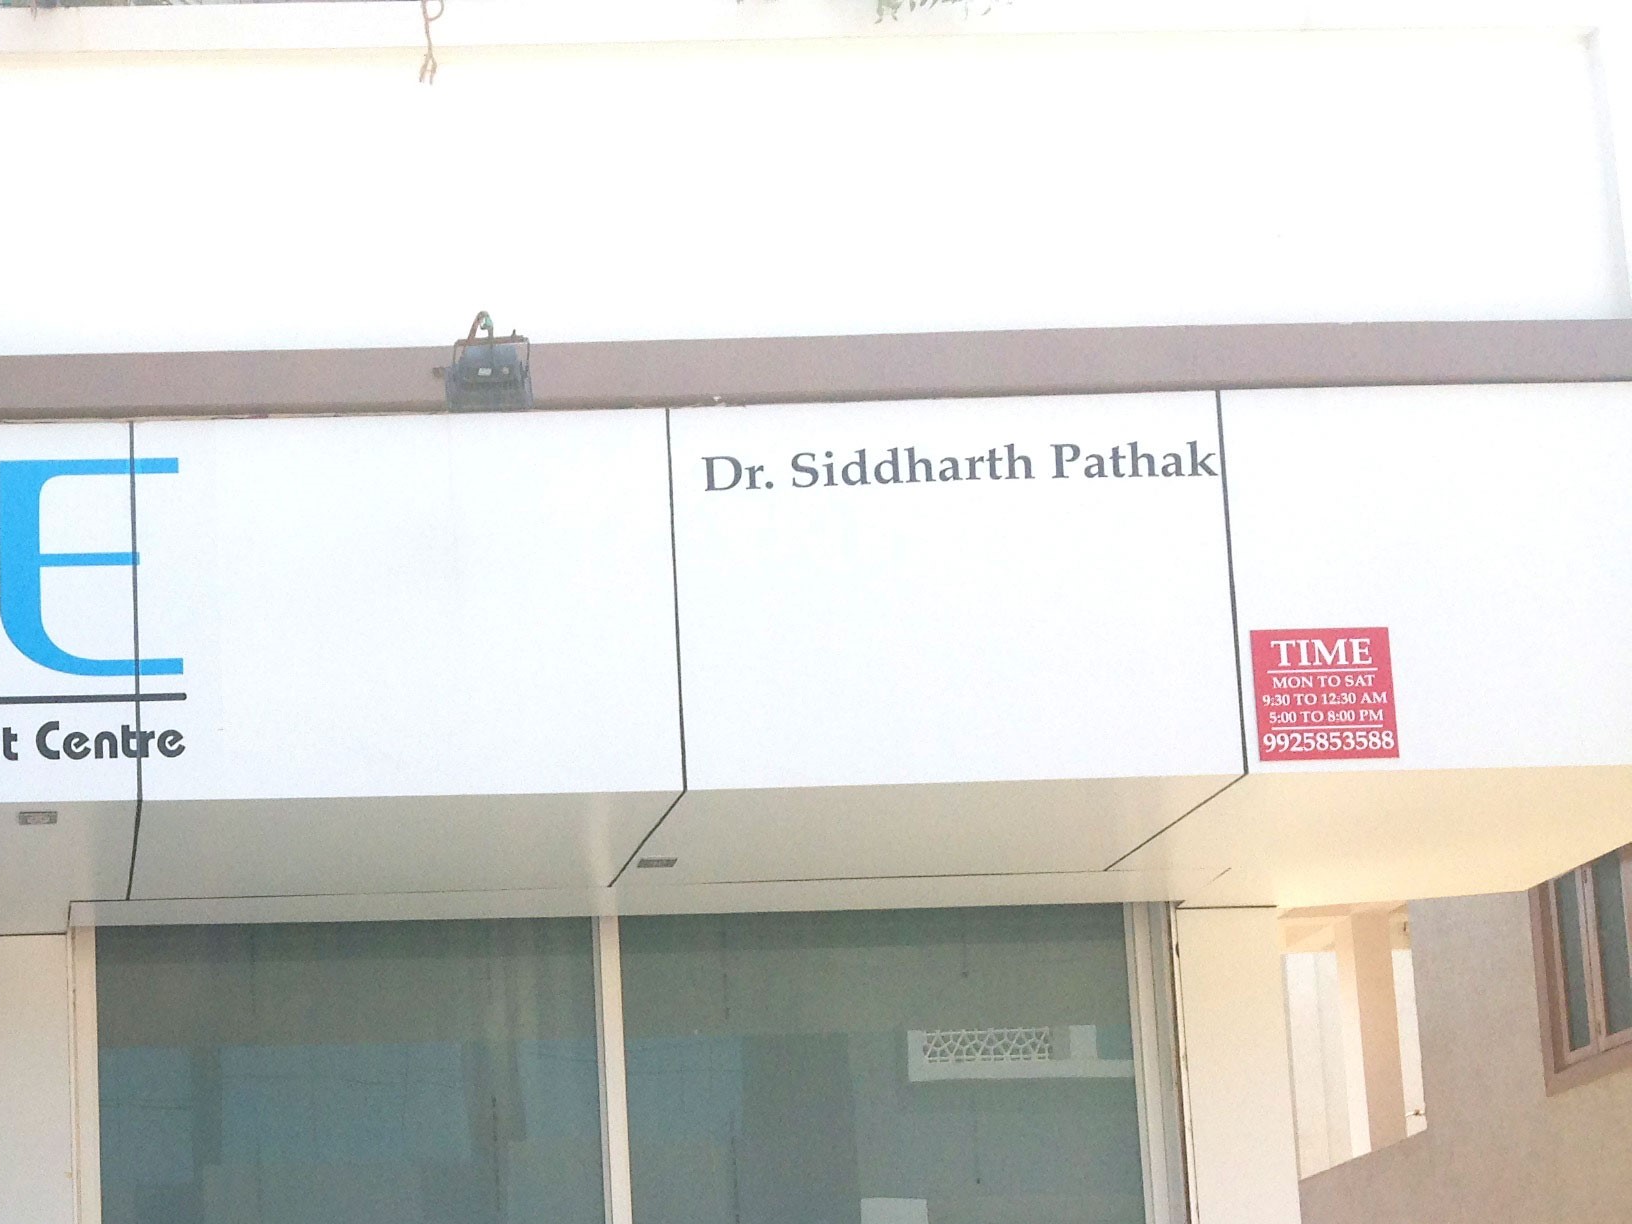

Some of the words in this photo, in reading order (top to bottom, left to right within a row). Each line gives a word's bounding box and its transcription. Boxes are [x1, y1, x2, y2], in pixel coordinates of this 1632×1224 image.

[703, 455, 774, 491] Dr.
[790, 443, 1035, 488] Siddharth
[1050, 440, 1218, 478] Pathak
[1270, 638, 1373, 667] TIME
[1272, 676, 1314, 689] MON
[1317, 675, 1341, 688] TO
[1344, 674, 1376, 687] SAT
[1262, 694, 1291, 707] 9:30
[1293, 694, 1318, 706] TO
[1321, 692, 1357, 705] 12:30
[1360, 691, 1388, 704] AM
[1269, 711, 1298, 724] 5:00
[1299, 711, 1325, 723] TO
[1327, 710, 1356, 722] 8:00
[1359, 709, 1384, 721] PM
[35, 721, 186, 762] Centre
[1262, 730, 1395, 753] 9925853588
